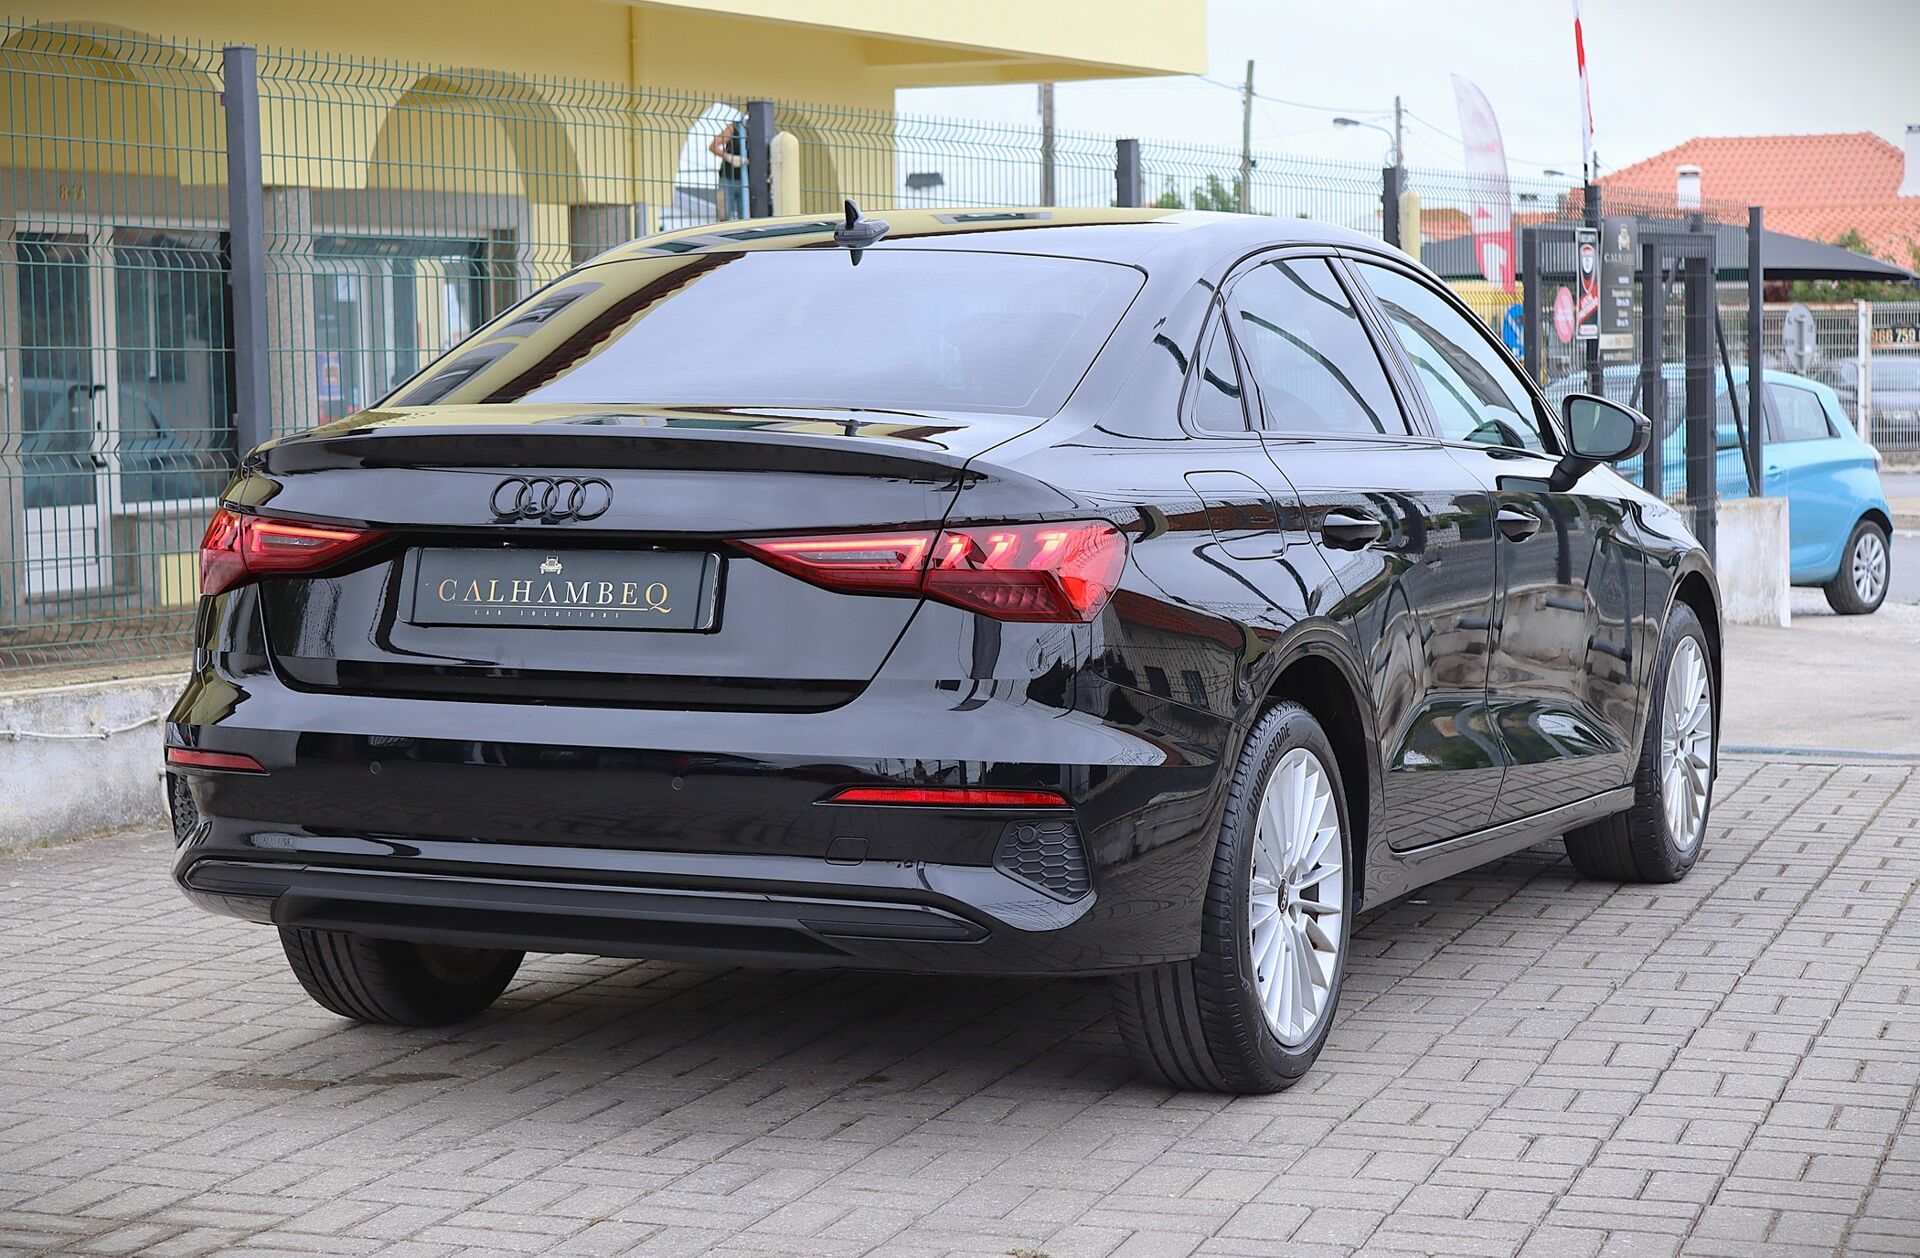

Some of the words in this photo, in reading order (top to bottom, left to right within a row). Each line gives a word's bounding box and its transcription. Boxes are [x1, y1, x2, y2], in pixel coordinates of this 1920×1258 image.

[438, 579, 672, 613] CALHAMBEQ
[520, 610, 620, 619] SOLUTIONS
[1247, 722, 1291, 818] BRIDGESTONE
